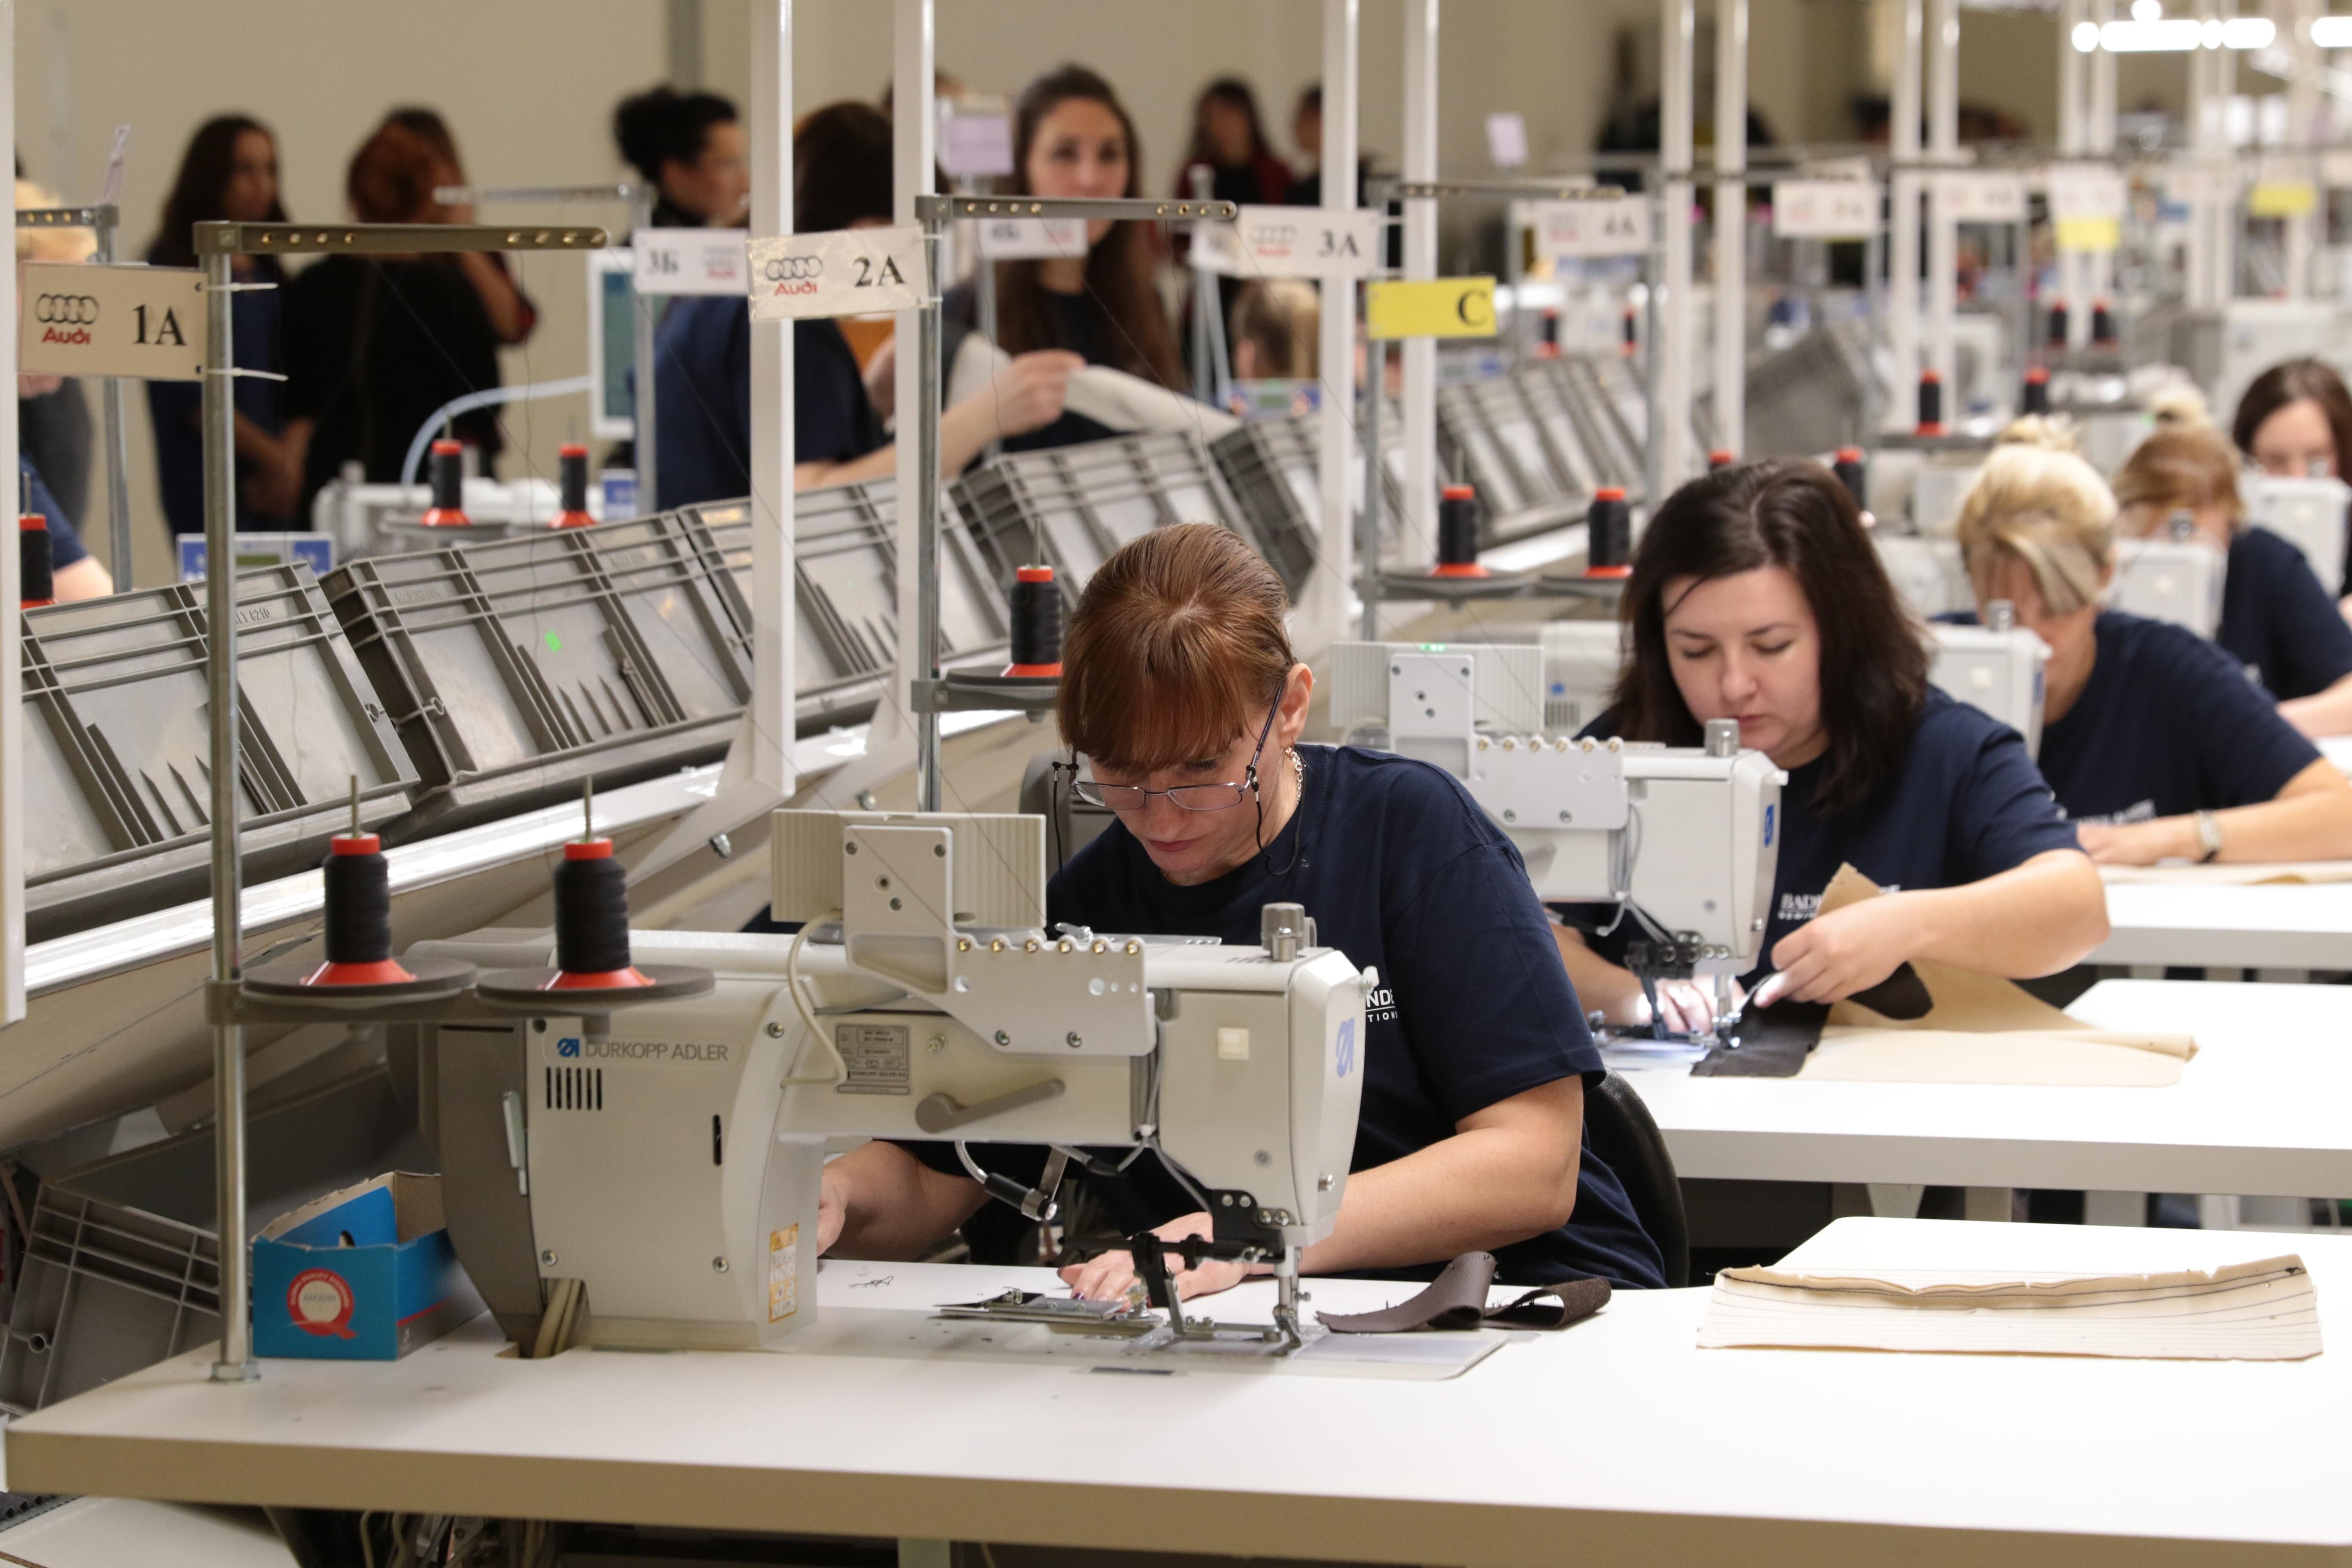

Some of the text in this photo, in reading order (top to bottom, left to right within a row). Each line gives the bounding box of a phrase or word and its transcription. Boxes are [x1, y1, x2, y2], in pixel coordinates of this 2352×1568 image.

[1318, 229, 1361, 257] 3A
[853, 254, 906, 288] 2A
[774, 281, 818, 296] Audi
[1458, 288, 1488, 327] C
[42, 326, 91, 344] Audi
[133, 303, 186, 346] 1A
[671, 1043, 728, 1061] ADLER
